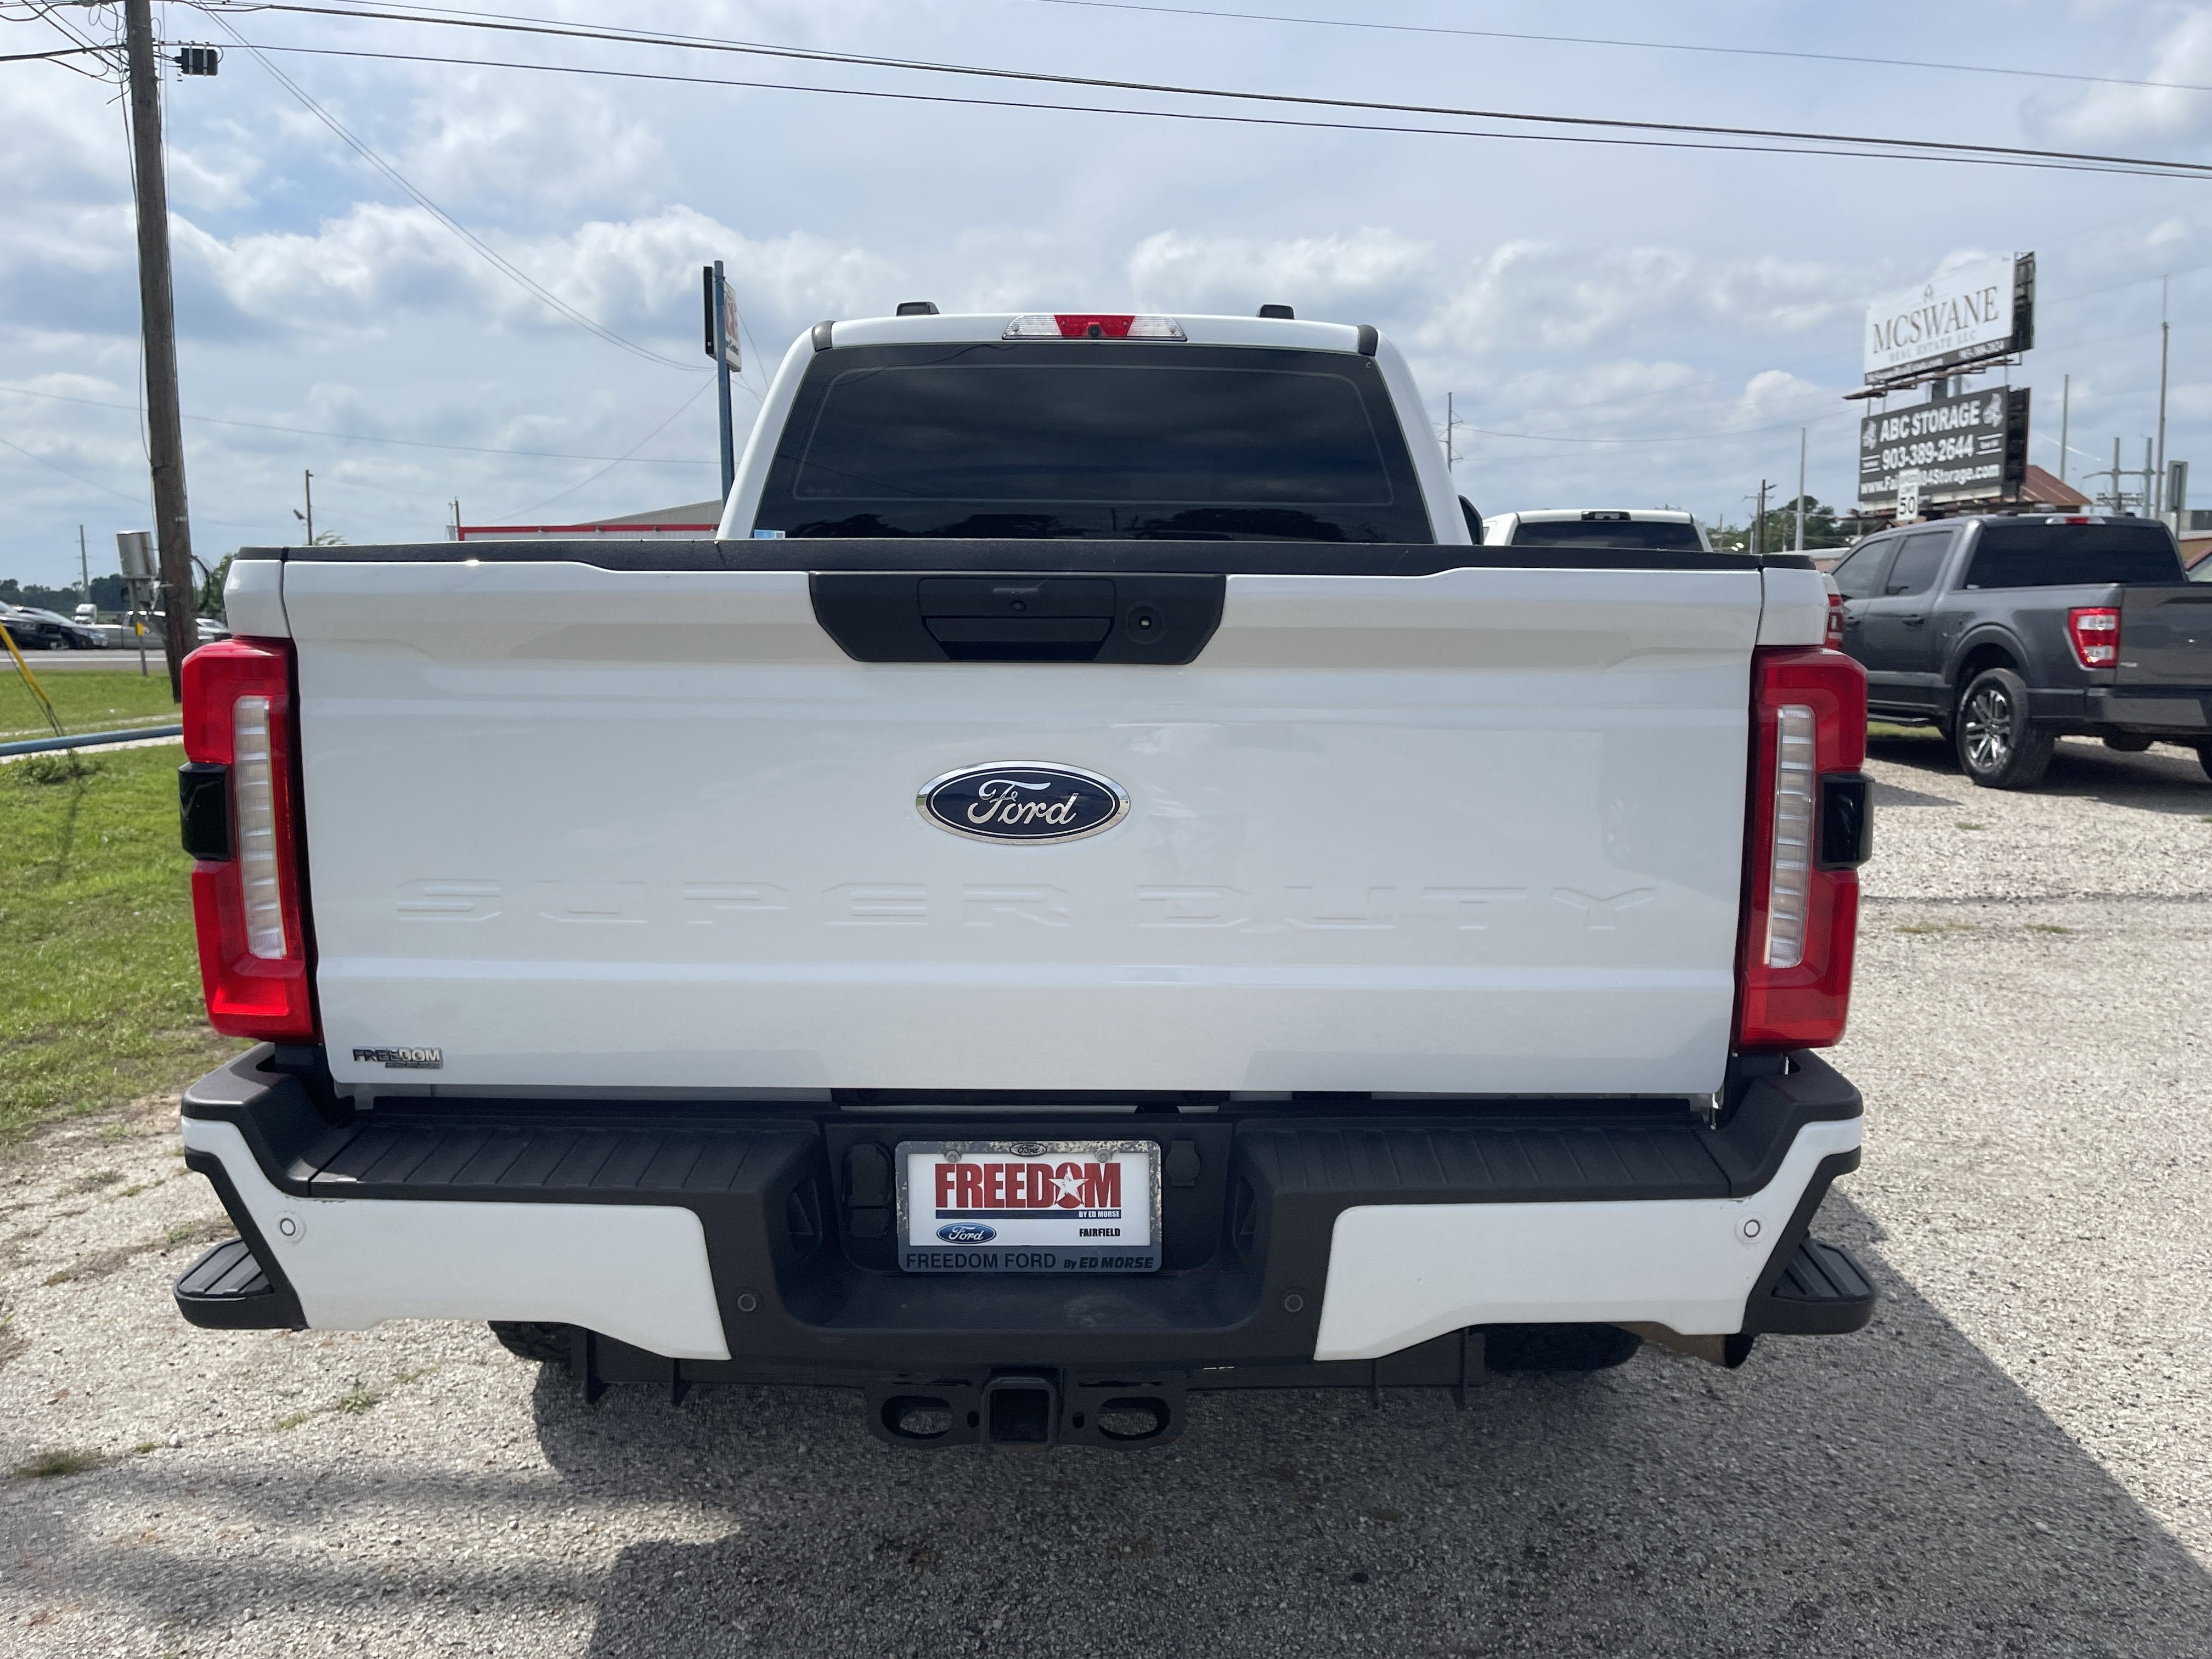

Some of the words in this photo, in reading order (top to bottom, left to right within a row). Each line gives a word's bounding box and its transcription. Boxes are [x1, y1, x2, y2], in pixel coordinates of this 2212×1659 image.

[1880, 414, 1910, 443] ABC
[1911, 399, 1981, 437] STORAGE
[1899, 496, 1916, 515] 50
[967, 778, 1079, 825] Ford
[395, 878, 1071, 927] SUPER
[1133, 884, 1657, 931] DUTY
[352, 1047, 442, 1062] FREEDOM
[935, 1162, 1121, 1209] FREEDOM
[948, 1226, 984, 1240] Ford
[1079, 1228, 1120, 1237] FAIRFIELD
[906, 1253, 998, 1269] FREEDOM
[1004, 1253, 1057, 1269] FORD
[1079, 1256, 1098, 1269] ED
[1100, 1256, 1155, 1269] MORSE
